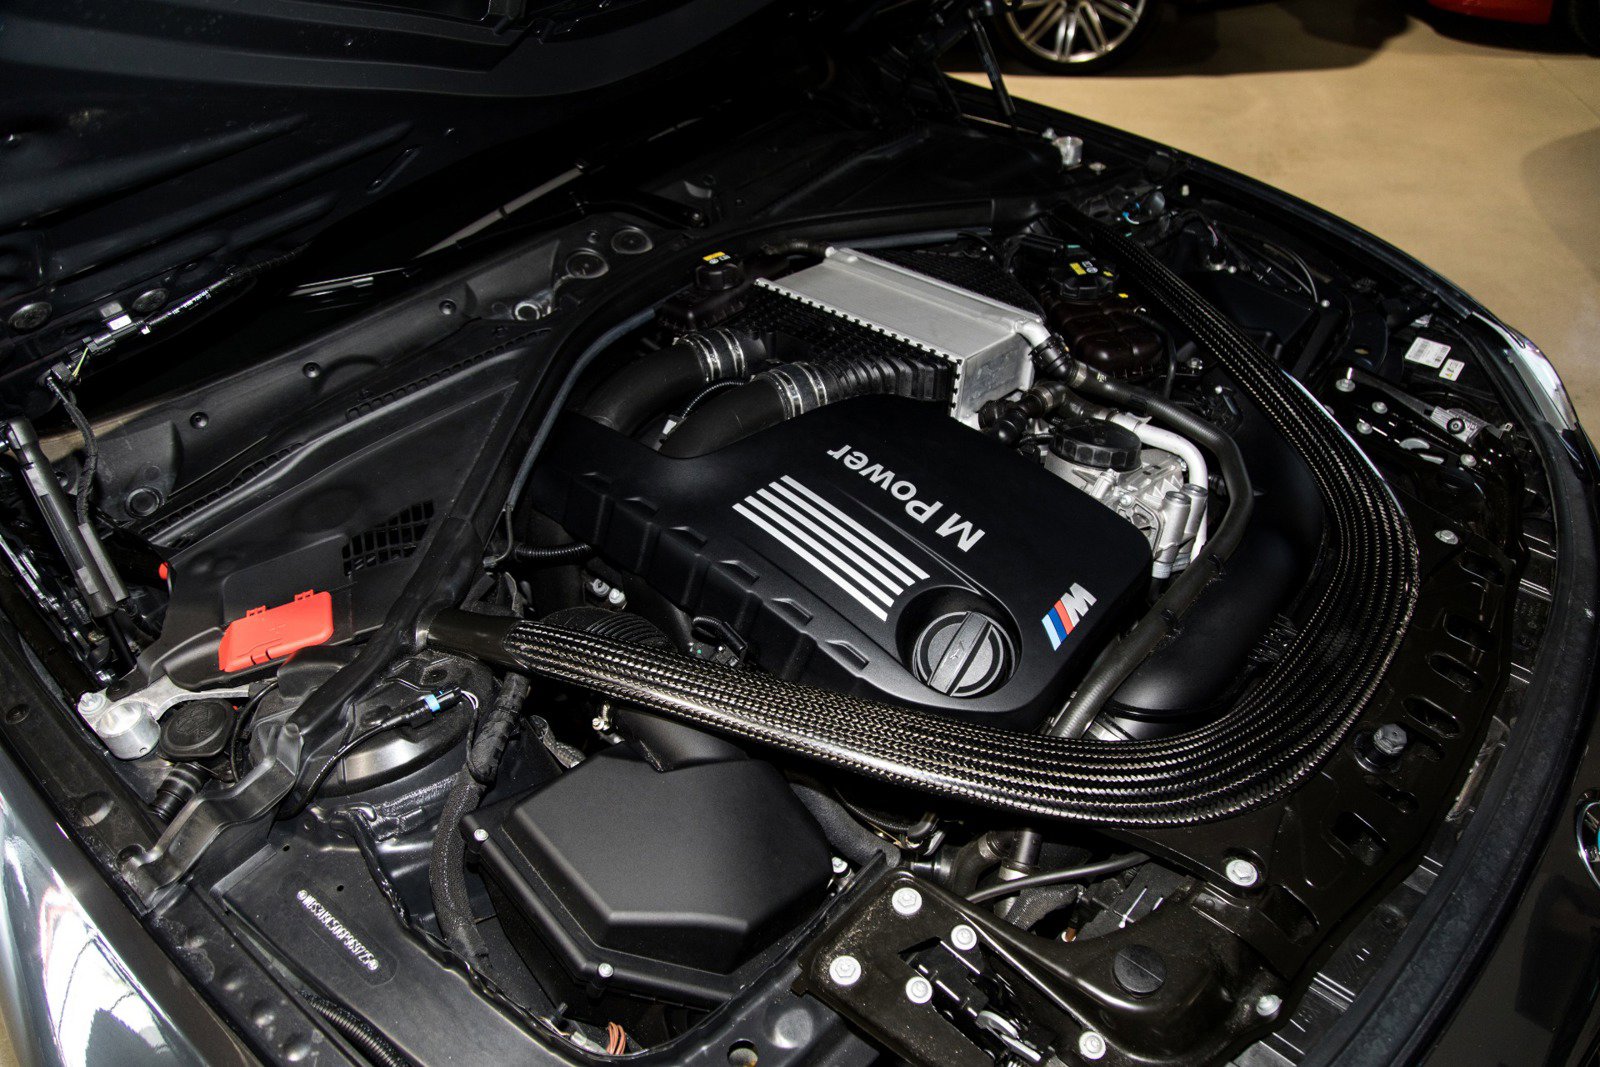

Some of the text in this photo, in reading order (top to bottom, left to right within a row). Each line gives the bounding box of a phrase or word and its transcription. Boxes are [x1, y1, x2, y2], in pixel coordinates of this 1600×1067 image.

[827, 444, 986, 552] M Power
[1060, 582, 1098, 627] M
